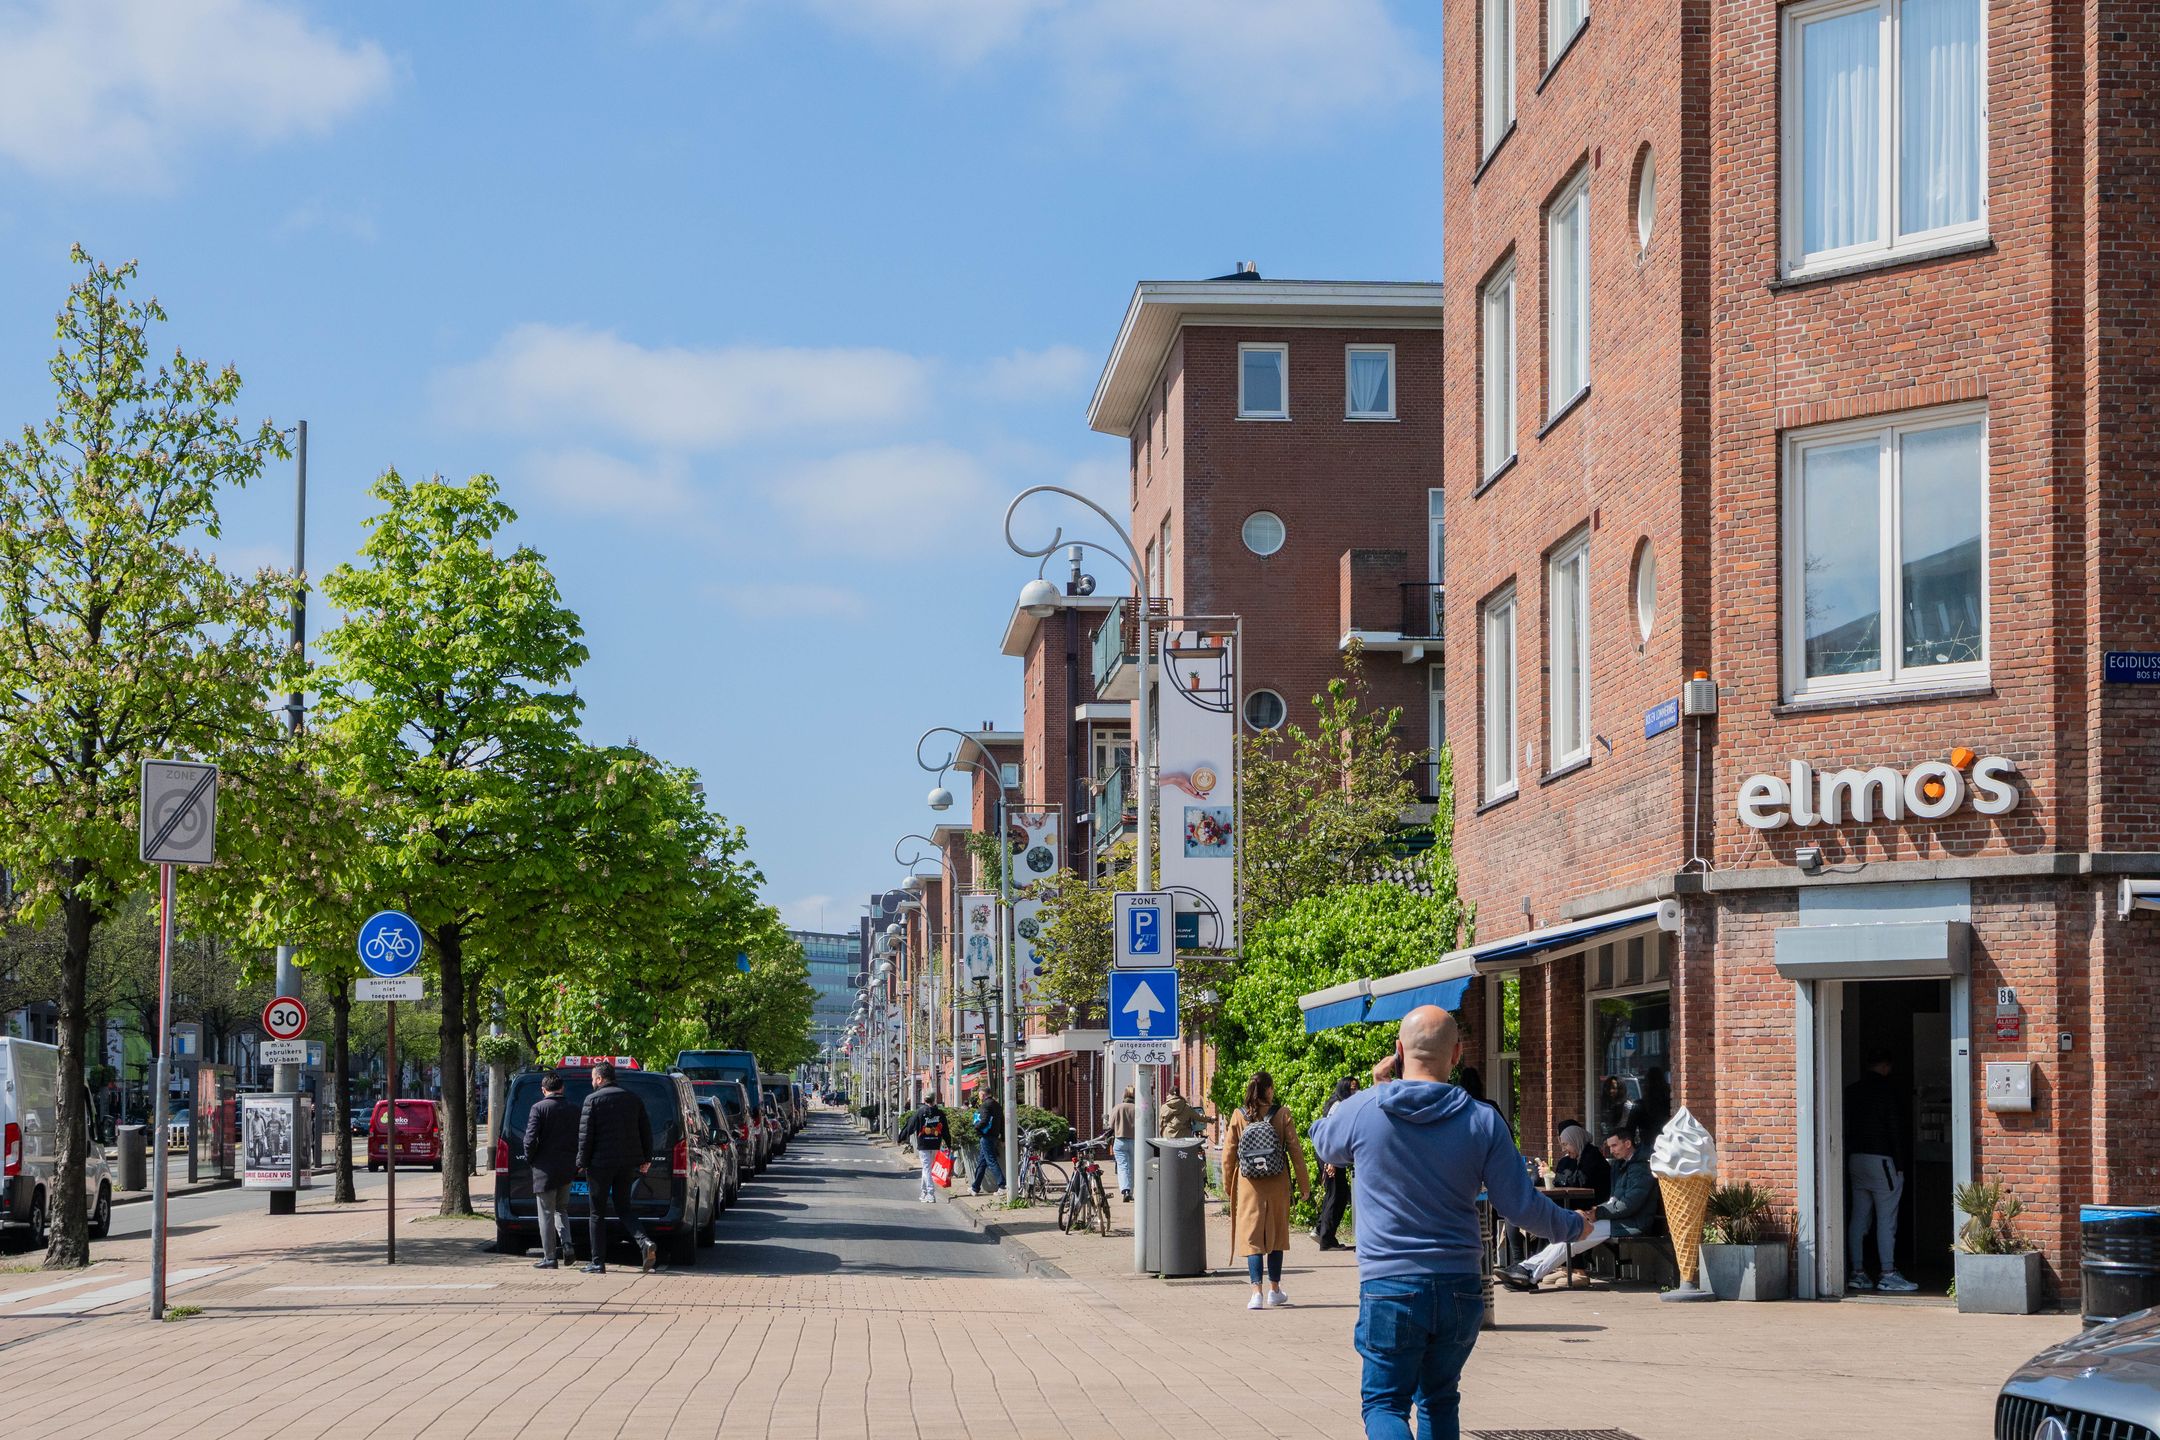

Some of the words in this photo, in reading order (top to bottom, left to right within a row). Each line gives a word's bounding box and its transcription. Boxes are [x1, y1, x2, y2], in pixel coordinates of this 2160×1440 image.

[2136, 671, 2150, 679] BOS
[166, 769, 197, 780] ZONE
[1737, 747, 2019, 829] elmo's
[163, 807, 198, 832] 0
[1130, 897, 1157, 906] ZONE
[1135, 911, 1153, 935] P
[2000, 989, 2014, 1004] 89
[272, 1010, 299, 1027] 30
[1119, 1042, 1167, 1050] uitgezonderd
[265, 1049, 302, 1057] gebruikers
